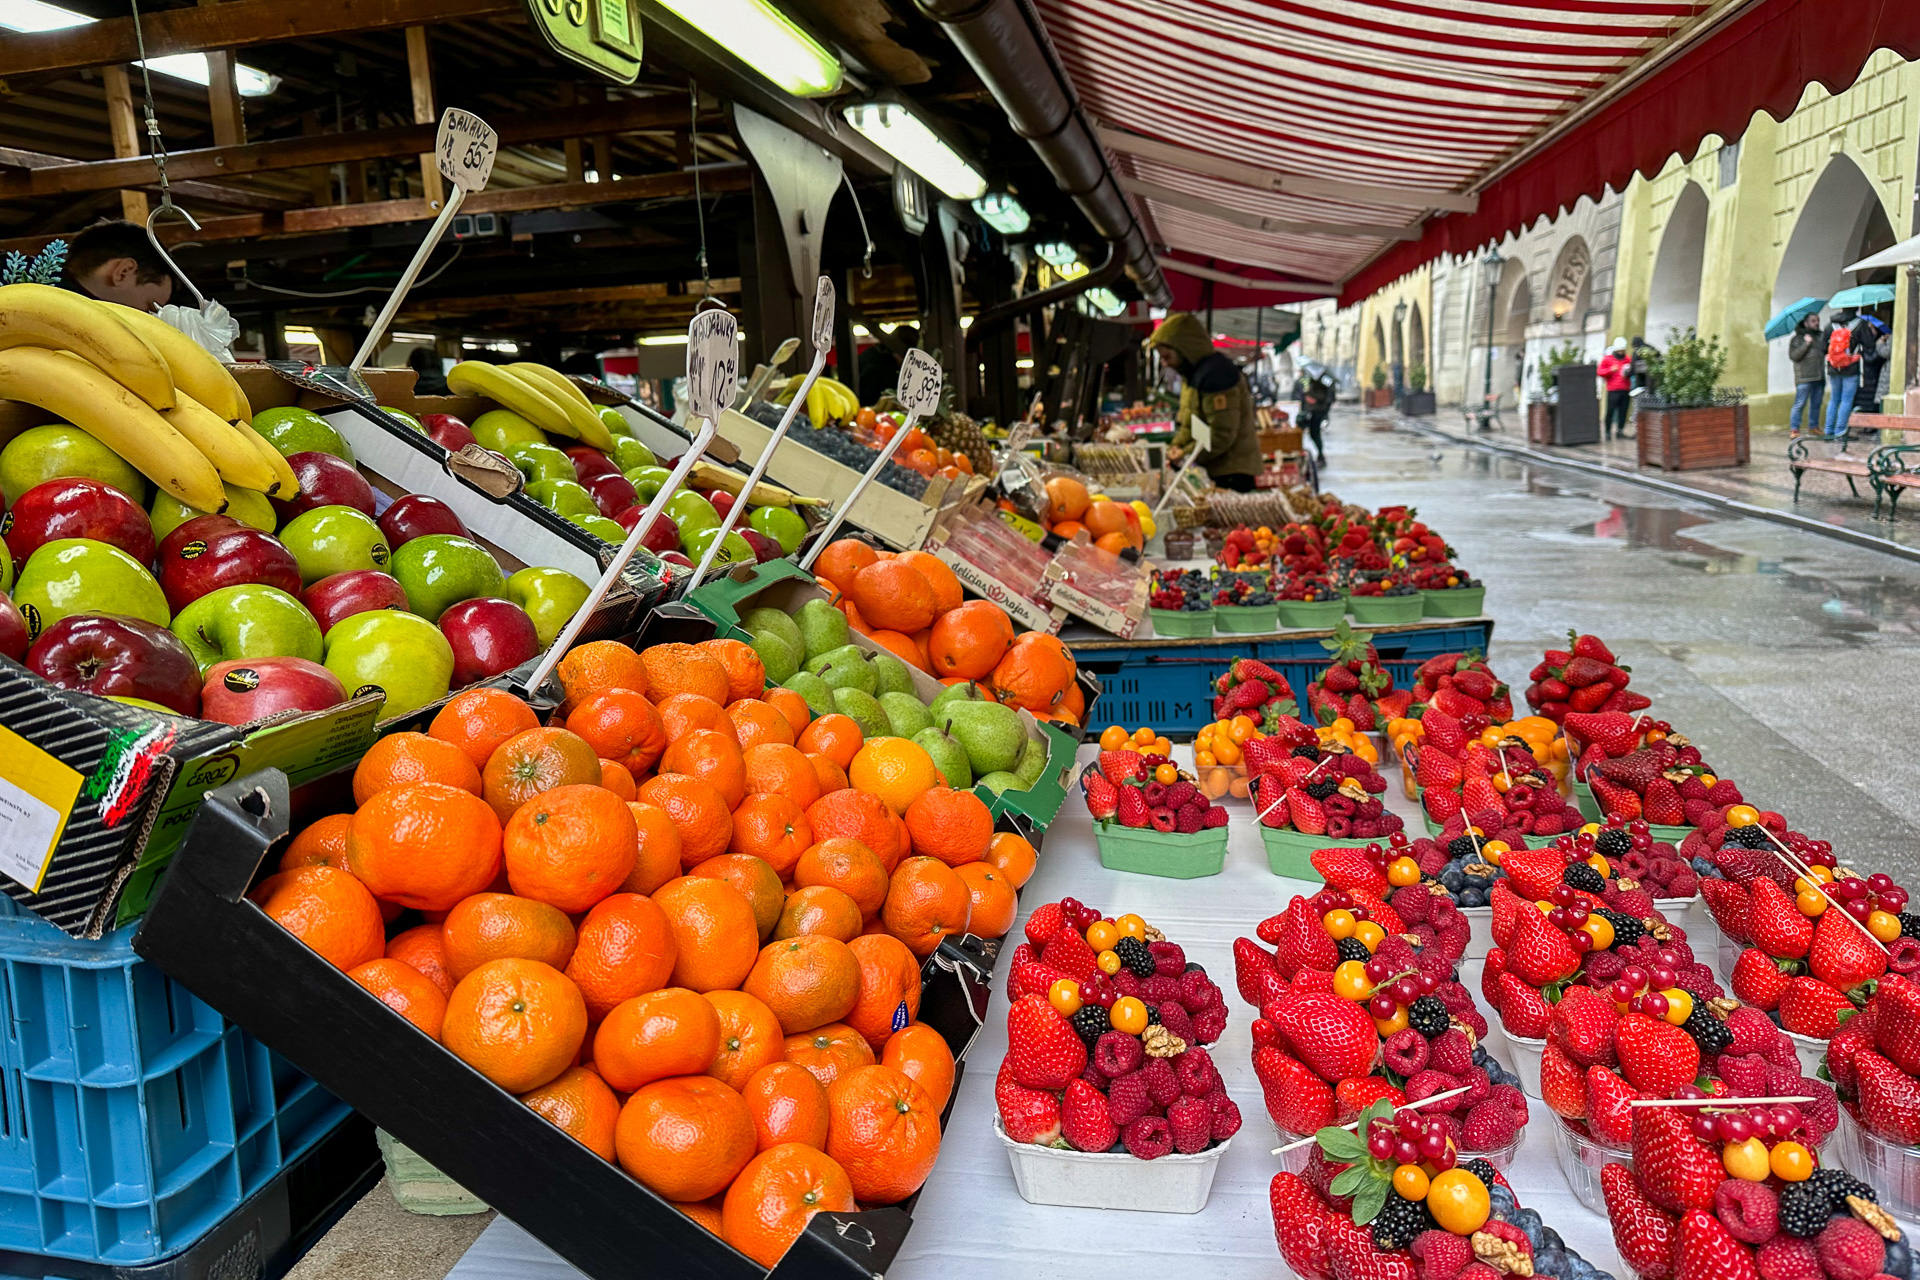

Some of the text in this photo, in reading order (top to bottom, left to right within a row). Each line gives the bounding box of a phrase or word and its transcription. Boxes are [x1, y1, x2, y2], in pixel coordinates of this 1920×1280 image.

[447, 111, 491, 144] BANANY
[951, 562, 1030, 620] delicias rojas
[1088, 605, 1106, 617] rojas
